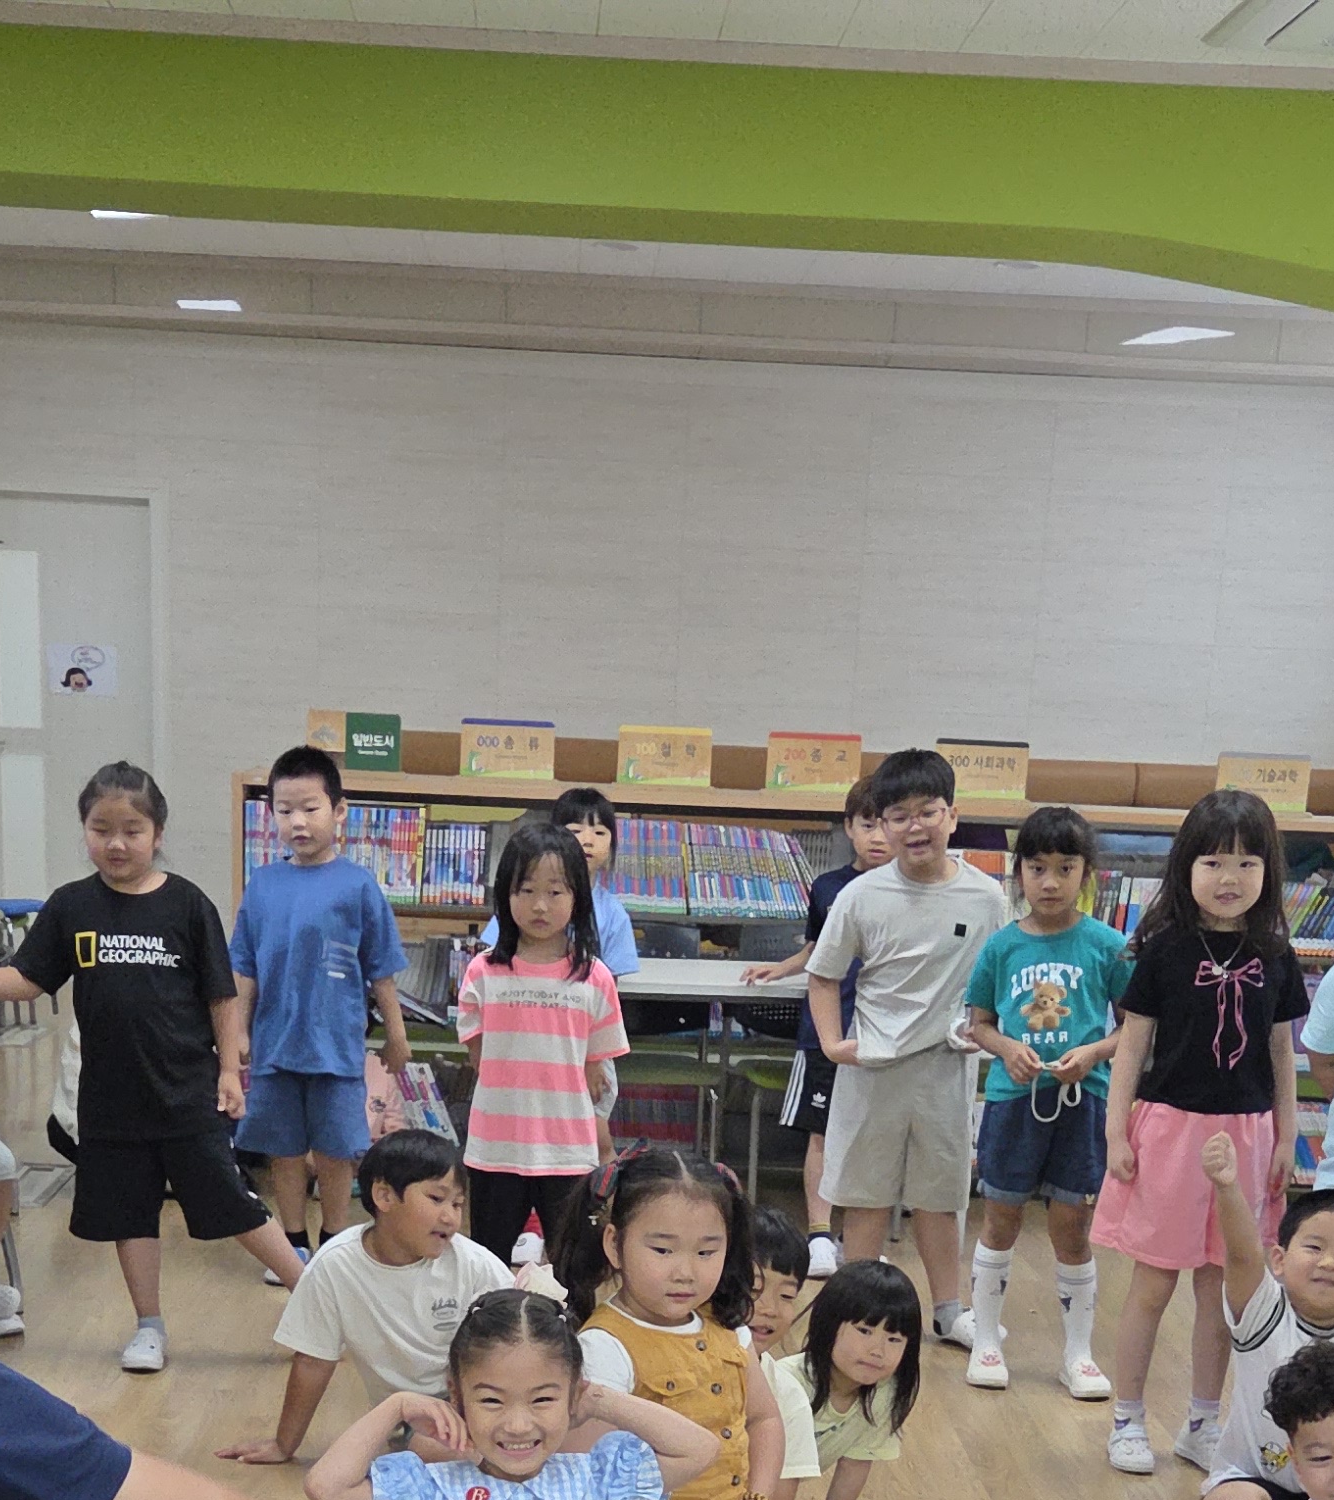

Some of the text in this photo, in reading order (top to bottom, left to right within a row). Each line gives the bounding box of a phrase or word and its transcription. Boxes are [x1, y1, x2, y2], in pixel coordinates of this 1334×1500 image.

[352, 733, 395, 749] 일반도서
[99, 934, 167, 951] NATIONAL
[98, 949, 181, 968] GEOGRAPHIC
[1011, 962, 1084, 999] LUCKY
[1021, 1031, 1069, 1045] BEAR
